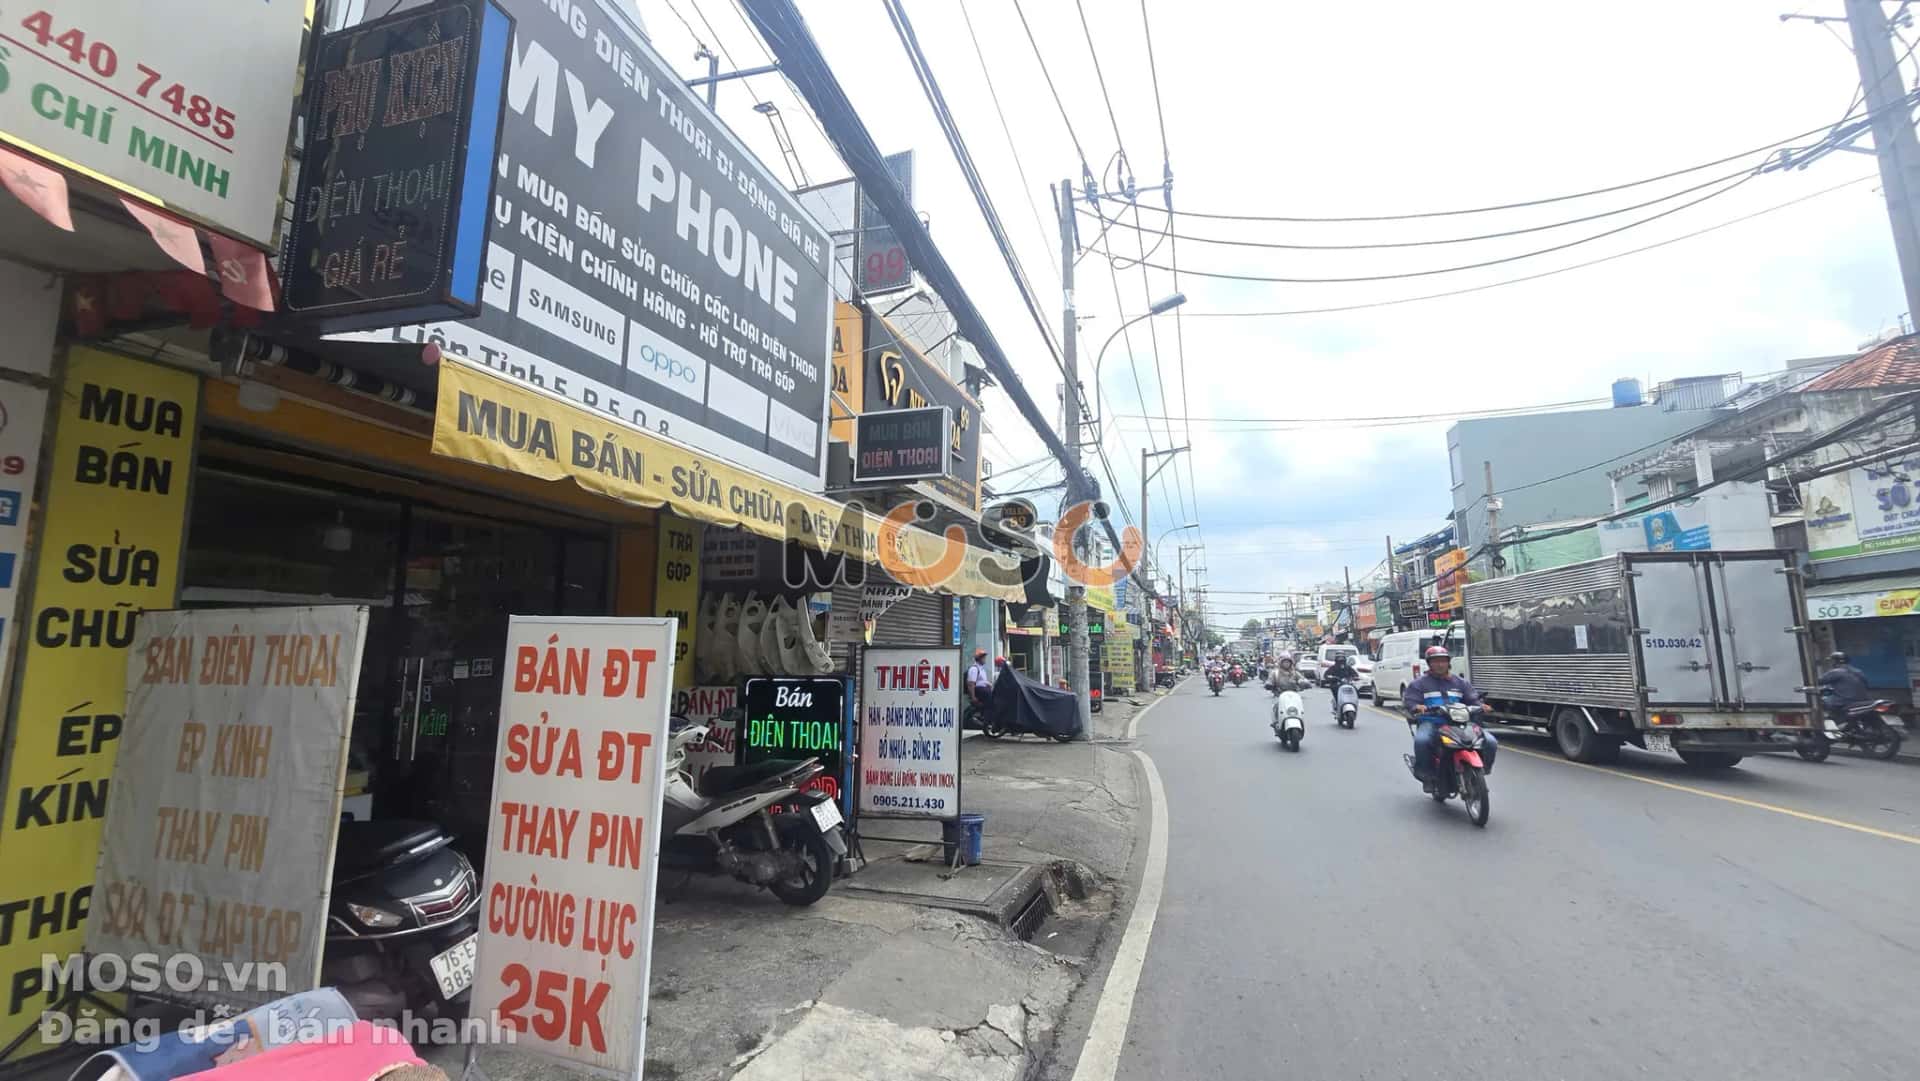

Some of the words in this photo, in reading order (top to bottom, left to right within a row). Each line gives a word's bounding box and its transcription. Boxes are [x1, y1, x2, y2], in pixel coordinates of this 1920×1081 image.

[21, 10, 118, 78] 440
[136, 63, 236, 140] 7485
[31, 82, 118, 145] CHÍ
[128, 126, 230, 200] MINH
[594, 28, 650, 102] ĐIỆN
[657, 88, 713, 161] THOẠI
[737, 170, 777, 222] ĐỘNG
[780, 212, 801, 247] GIÁ
[804, 233, 821, 263] RẺ
[371, 160, 447, 212] THOẠI
[507, 30, 615, 169] MY
[636, 135, 799, 325] PHONE
[323, 234, 368, 289] GIÁ
[370, 224, 408, 283] RẺ
[517, 163, 569, 219] MUA
[575, 203, 616, 249] BÁN
[620, 235, 656, 276] SỬA
[704, 293, 731, 324] CÁC
[733, 312, 760, 345] LOẠI
[761, 333, 788, 363] ĐIỆN
[789, 350, 818, 384] THOẠI
[519, 210, 575, 264] KIỆN
[580, 248, 638, 302] CHÍNH
[642, 287, 687, 331] HÀNG
[721, 335, 747, 369] TRỢ
[749, 353, 773, 382] TRẢ
[774, 369, 796, 393] GÓP
[527, 287, 617, 346] SAMSUNG
[79, 383, 183, 438] MUA
[75, 441, 172, 495] BÁN
[457, 390, 559, 461] MUA
[571, 431, 643, 486] BÁN
[671, 459, 722, 509] SỬA
[729, 486, 784, 528] CHỮA
[62, 528, 160, 588] SỬA
[36, 601, 140, 649] CHỮ
[1843, 605, 1863, 617] 23
[513, 633, 591, 697] BÁN
[602, 648, 657, 700] ĐT
[1645, 638, 1702, 649] 51D.030.42
[775, 686, 814, 708] Bán
[874, 659, 951, 697] THIỆN
[56, 700, 123, 757] ÉP
[504, 711, 584, 779] SỬA
[597, 730, 652, 785] ĐT
[749, 713, 785, 754] ĐIỆN
[790, 720, 839, 757] THOẠI
[932, 740, 941, 761] XE
[15, 767, 109, 830] KÍN
[873, 795, 945, 809] 0905.211.430
[153, 806, 222, 866] THAY
[224, 813, 270, 873] PIN
[500, 801, 580, 861] THAY
[587, 812, 643, 871] PIN
[0, 884, 94, 946] THA
[199, 898, 304, 963] LAPTOP
[488, 872, 575, 948] CƯỜNG
[582, 896, 638, 973] LỰC
[498, 962, 612, 1054] 25K
